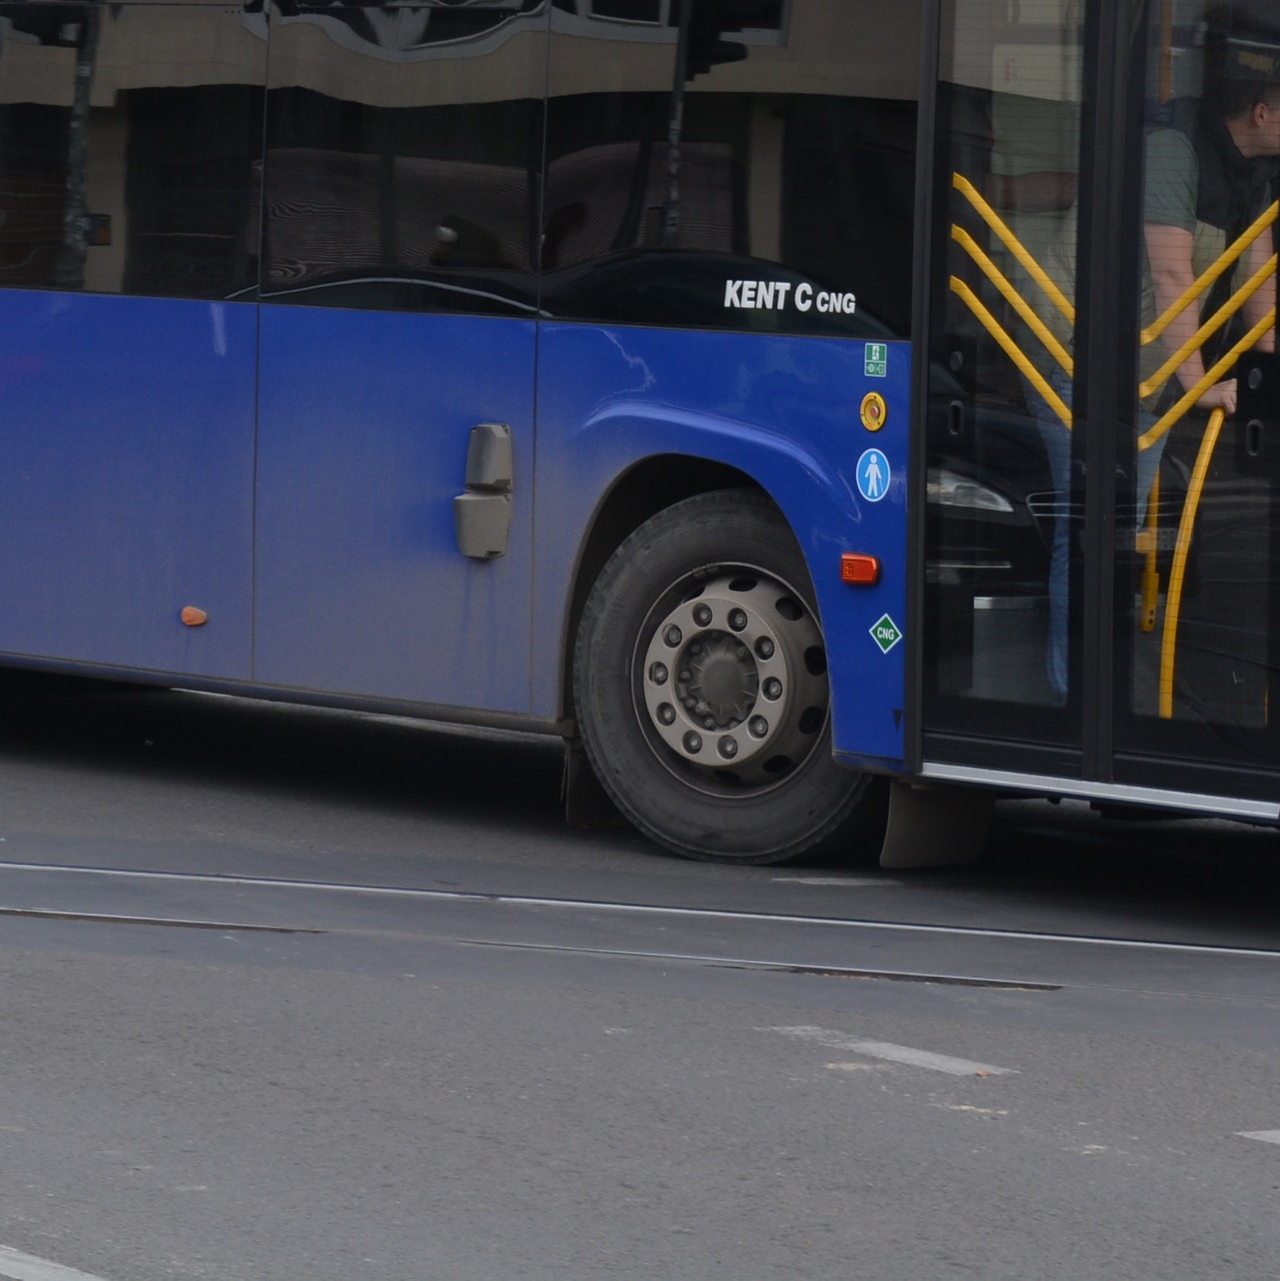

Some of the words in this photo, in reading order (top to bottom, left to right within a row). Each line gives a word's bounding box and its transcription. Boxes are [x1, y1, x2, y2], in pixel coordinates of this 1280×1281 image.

[723, 279, 792, 311] KENT
[794, 282, 814, 312] C
[816, 291, 857, 315] CNG
[876, 626, 895, 641] CNG
